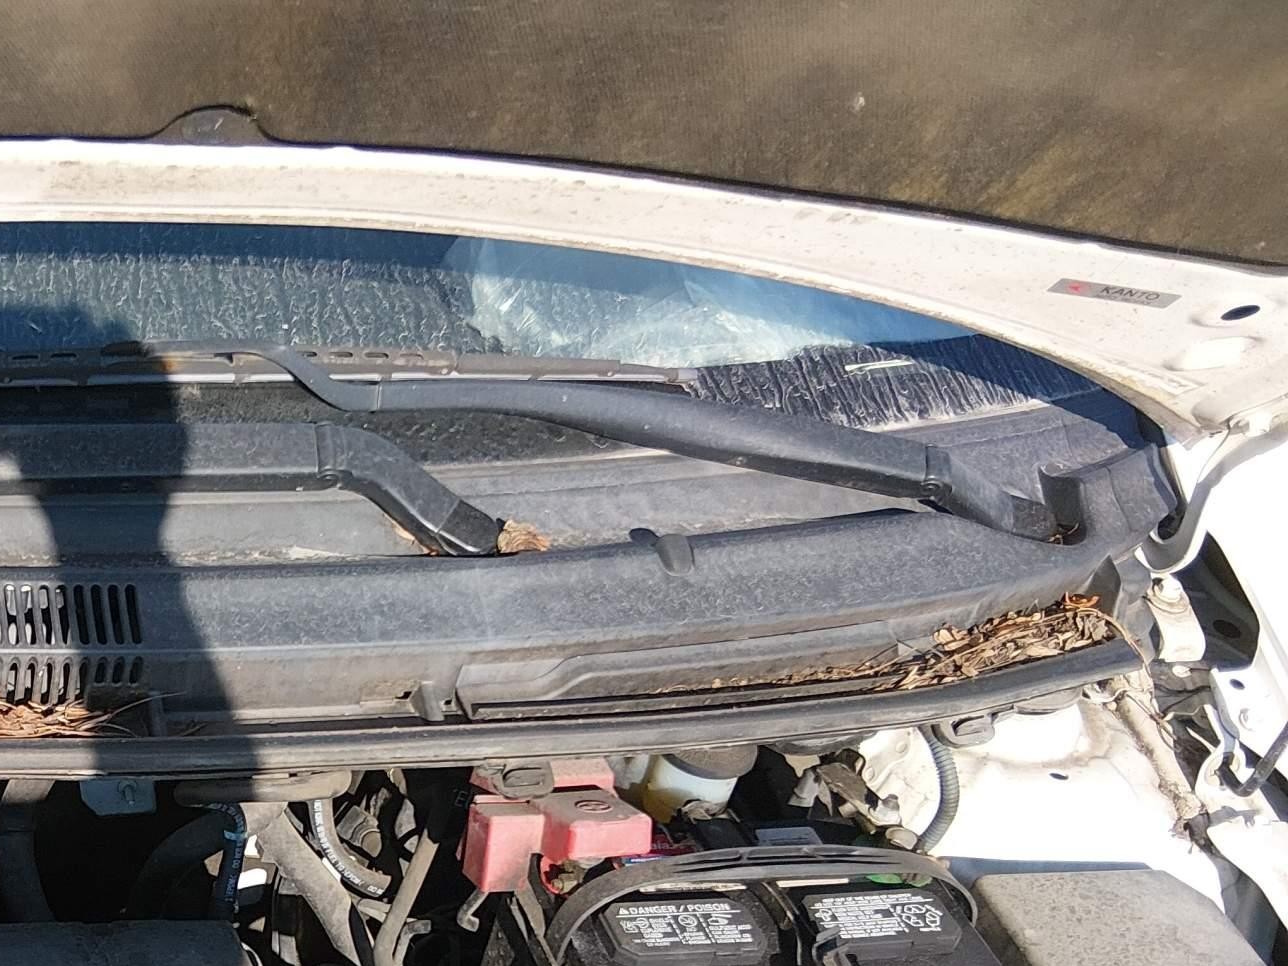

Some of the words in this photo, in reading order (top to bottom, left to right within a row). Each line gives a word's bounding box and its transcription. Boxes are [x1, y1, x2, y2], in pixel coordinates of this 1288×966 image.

[1100, 286, 1160, 300] KANTO
[628, 904, 677, 914] DANGER
[686, 903, 731, 912] POISON
